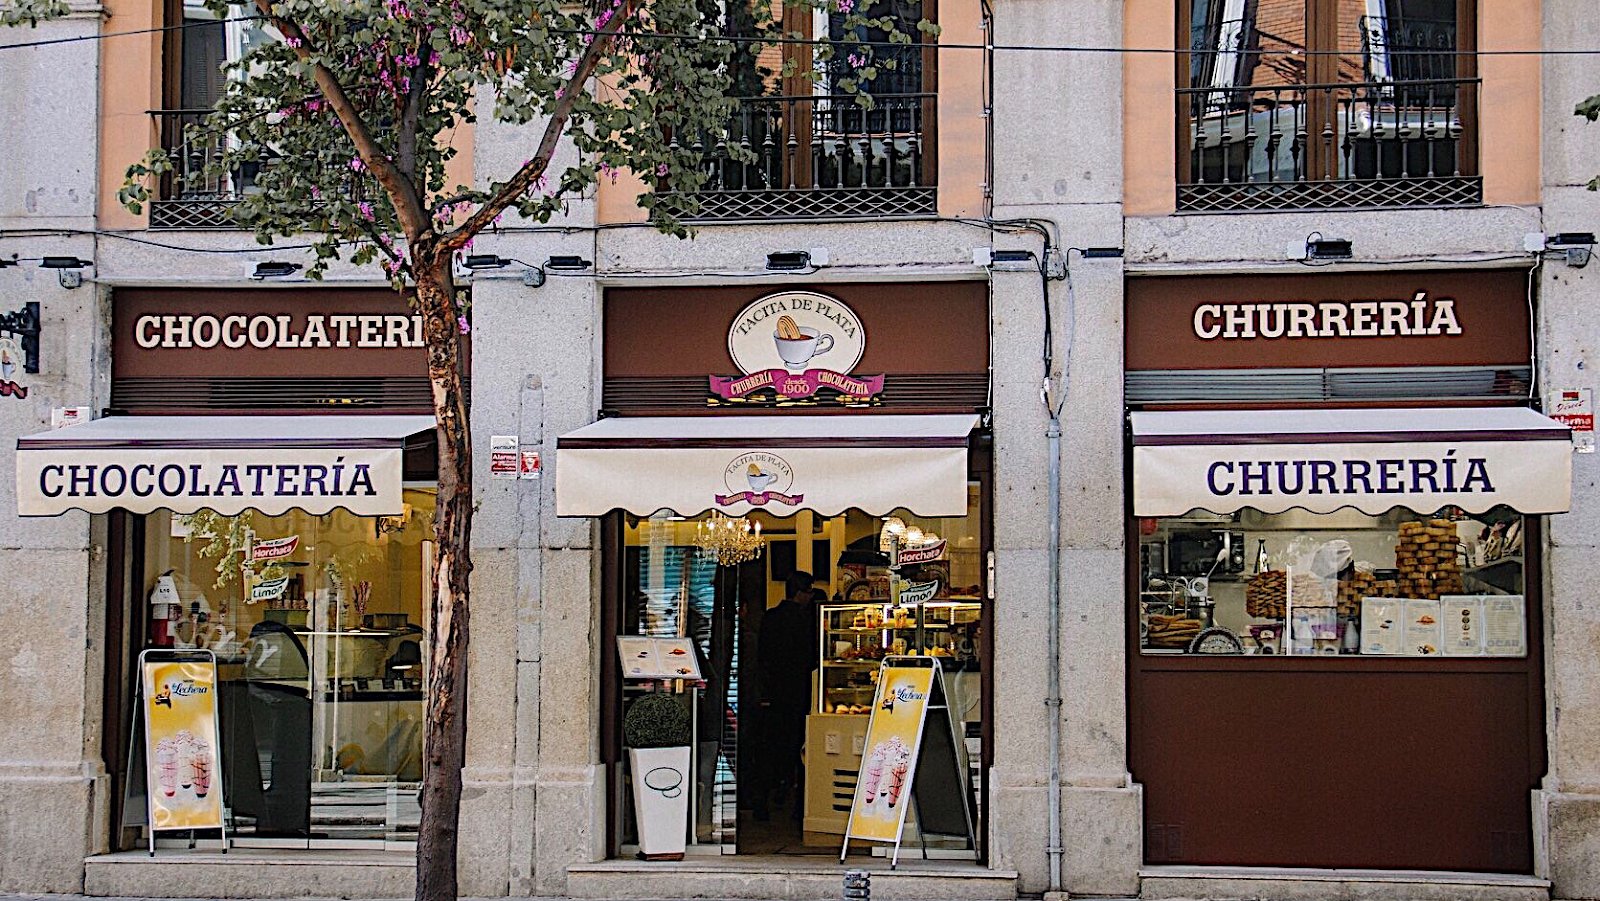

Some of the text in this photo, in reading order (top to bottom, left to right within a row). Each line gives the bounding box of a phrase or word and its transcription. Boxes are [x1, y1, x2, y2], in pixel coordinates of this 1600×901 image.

[736, 299, 857, 338] TACITA DE PLATA
[1194, 293, 1462, 338] CHURRERÍA
[135, 310, 426, 348] CHOCOLATERÍ
[731, 371, 773, 395] CHURRERÍA
[783, 384, 809, 394] 1900
[818, 371, 869, 395] CHOCOLATERÍA
[40, 456, 377, 497] CHOCOLATERÍA
[728, 455, 754, 474] TACITA
[768, 456, 790, 476] PLATA
[1207, 449, 1495, 496] CHURRERÍA
[254, 545, 292, 558] Horchata
[900, 549, 940, 562] Horchata
